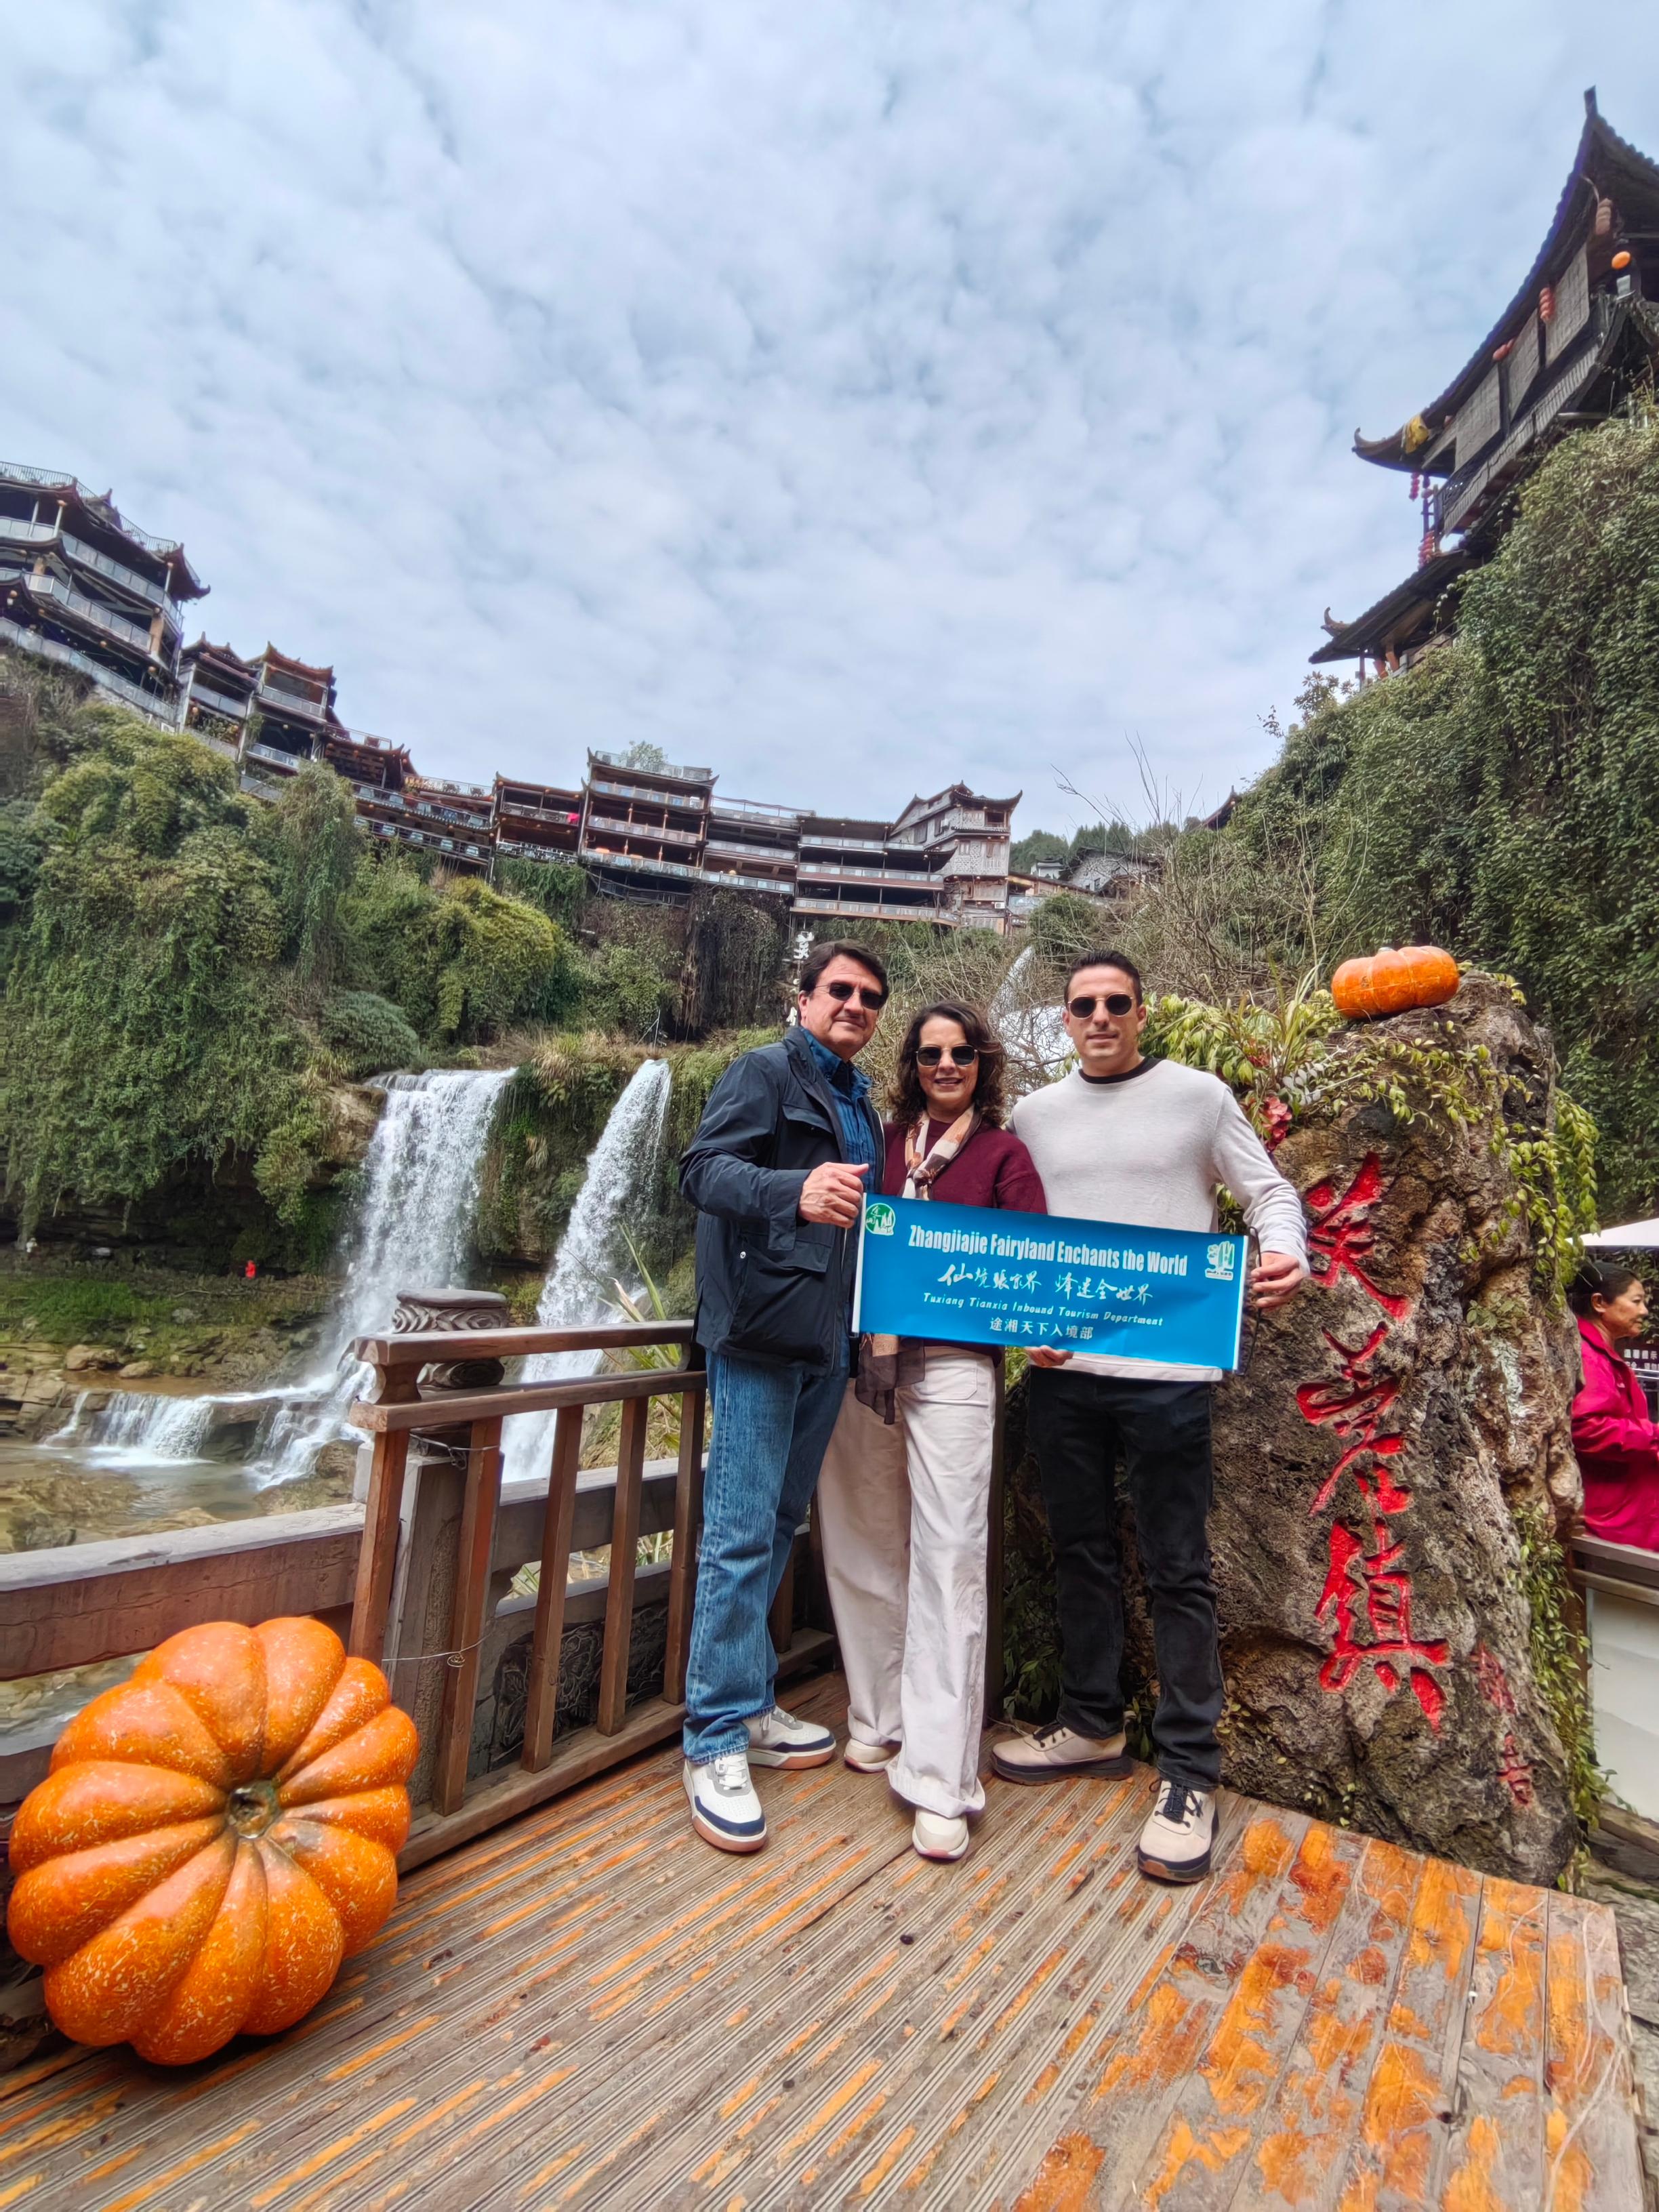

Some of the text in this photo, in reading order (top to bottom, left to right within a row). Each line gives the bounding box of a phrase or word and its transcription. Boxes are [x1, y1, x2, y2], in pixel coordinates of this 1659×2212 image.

[908, 1225, 1187, 1276] Zhangjiajie Fairyland Enchants the World
[923, 1292, 1164, 1326] Tuxiang Tianxia Inbound Tourism Department
[989, 1317, 1094, 1340] 途湘天下入境部
